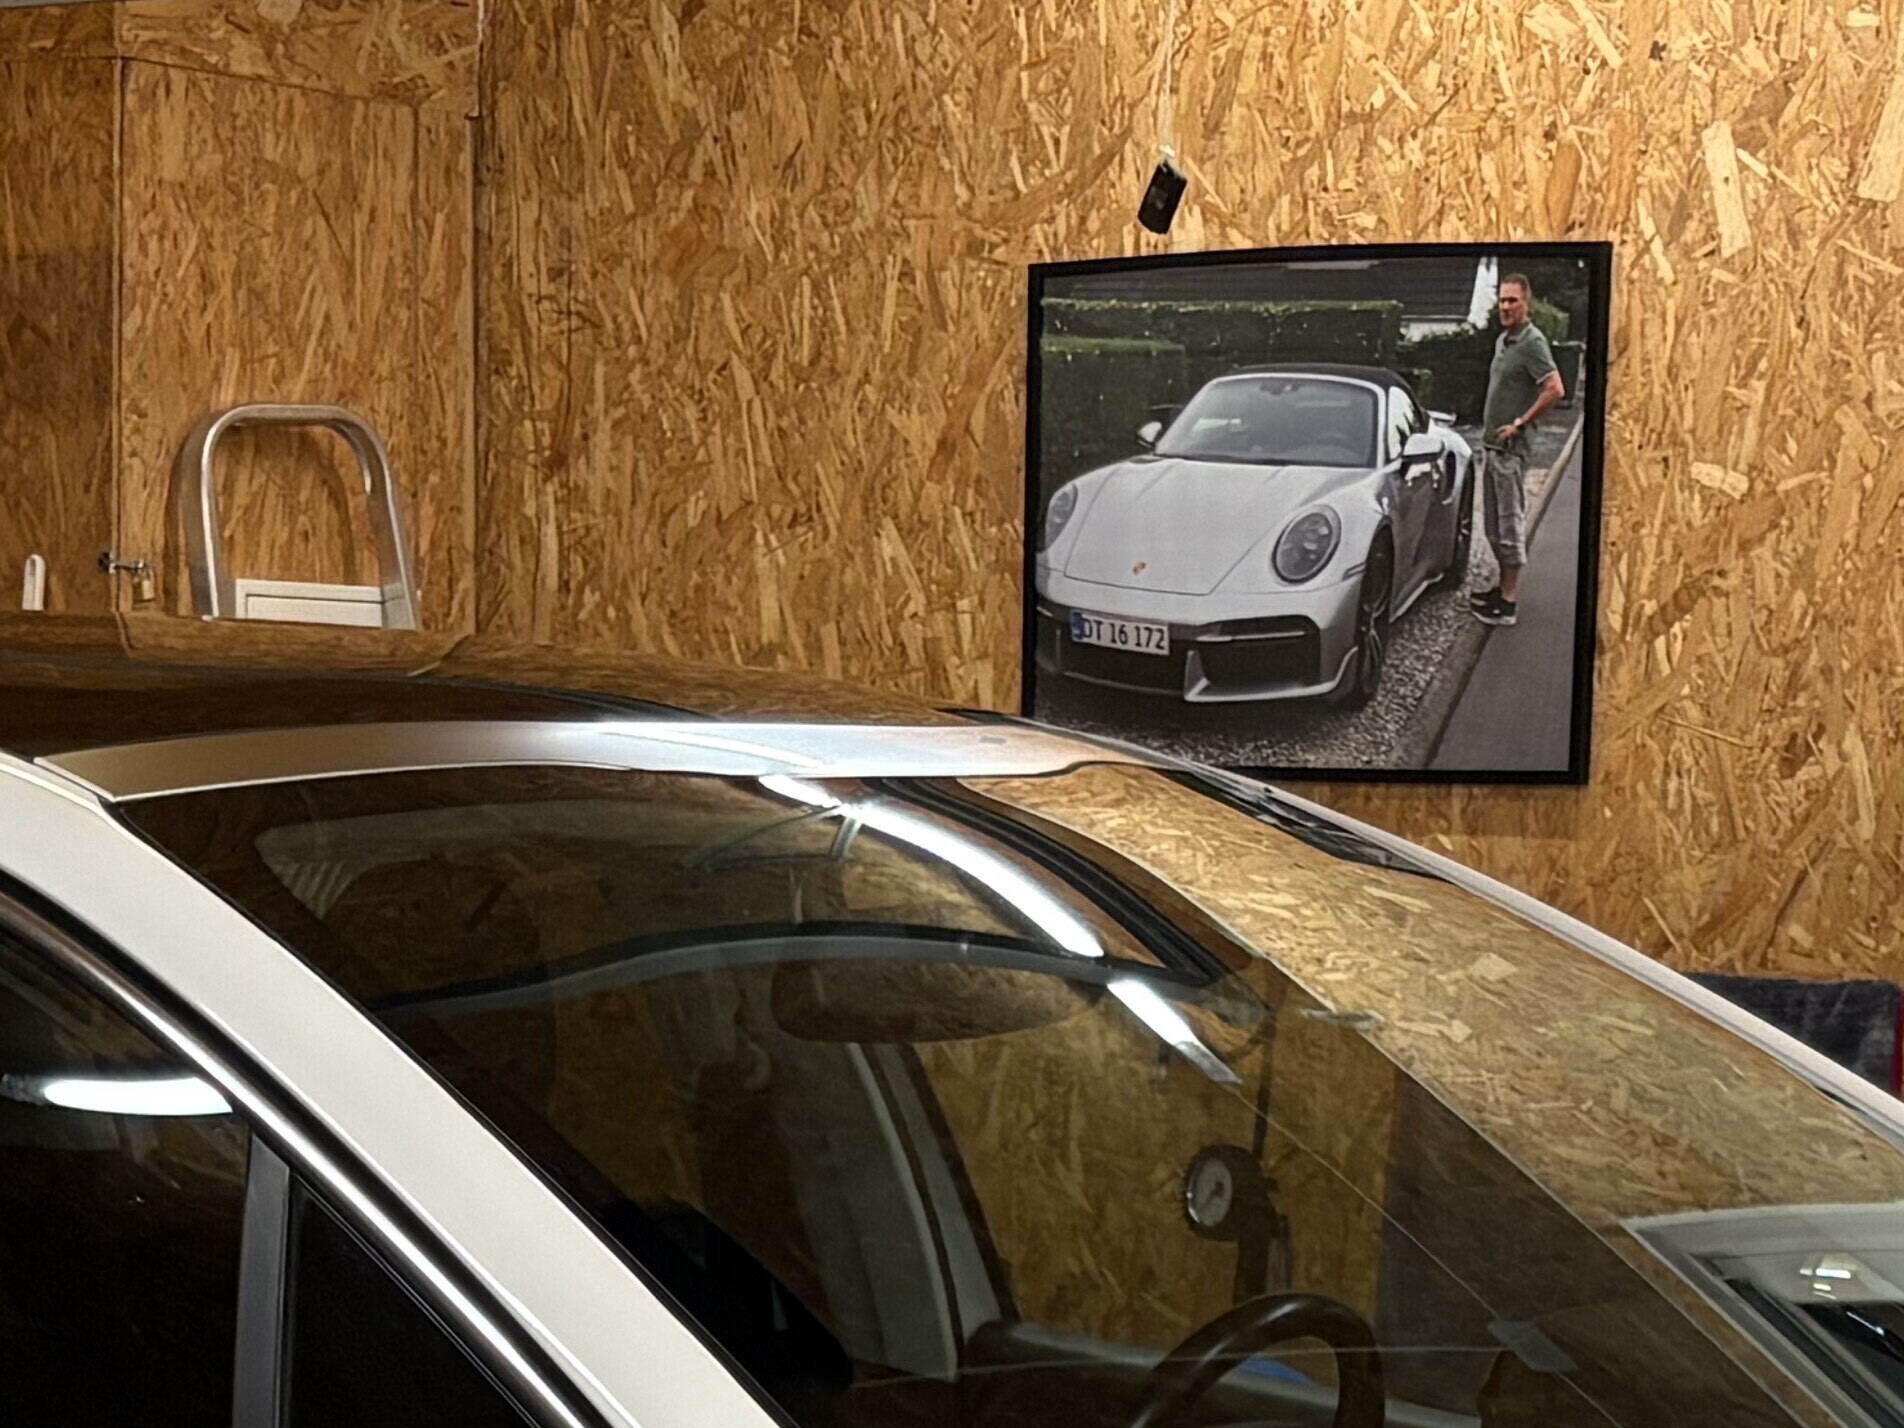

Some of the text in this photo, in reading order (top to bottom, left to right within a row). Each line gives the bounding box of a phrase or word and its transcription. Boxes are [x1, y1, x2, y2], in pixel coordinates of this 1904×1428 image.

[1080, 617, 1166, 650] DT 16 172
